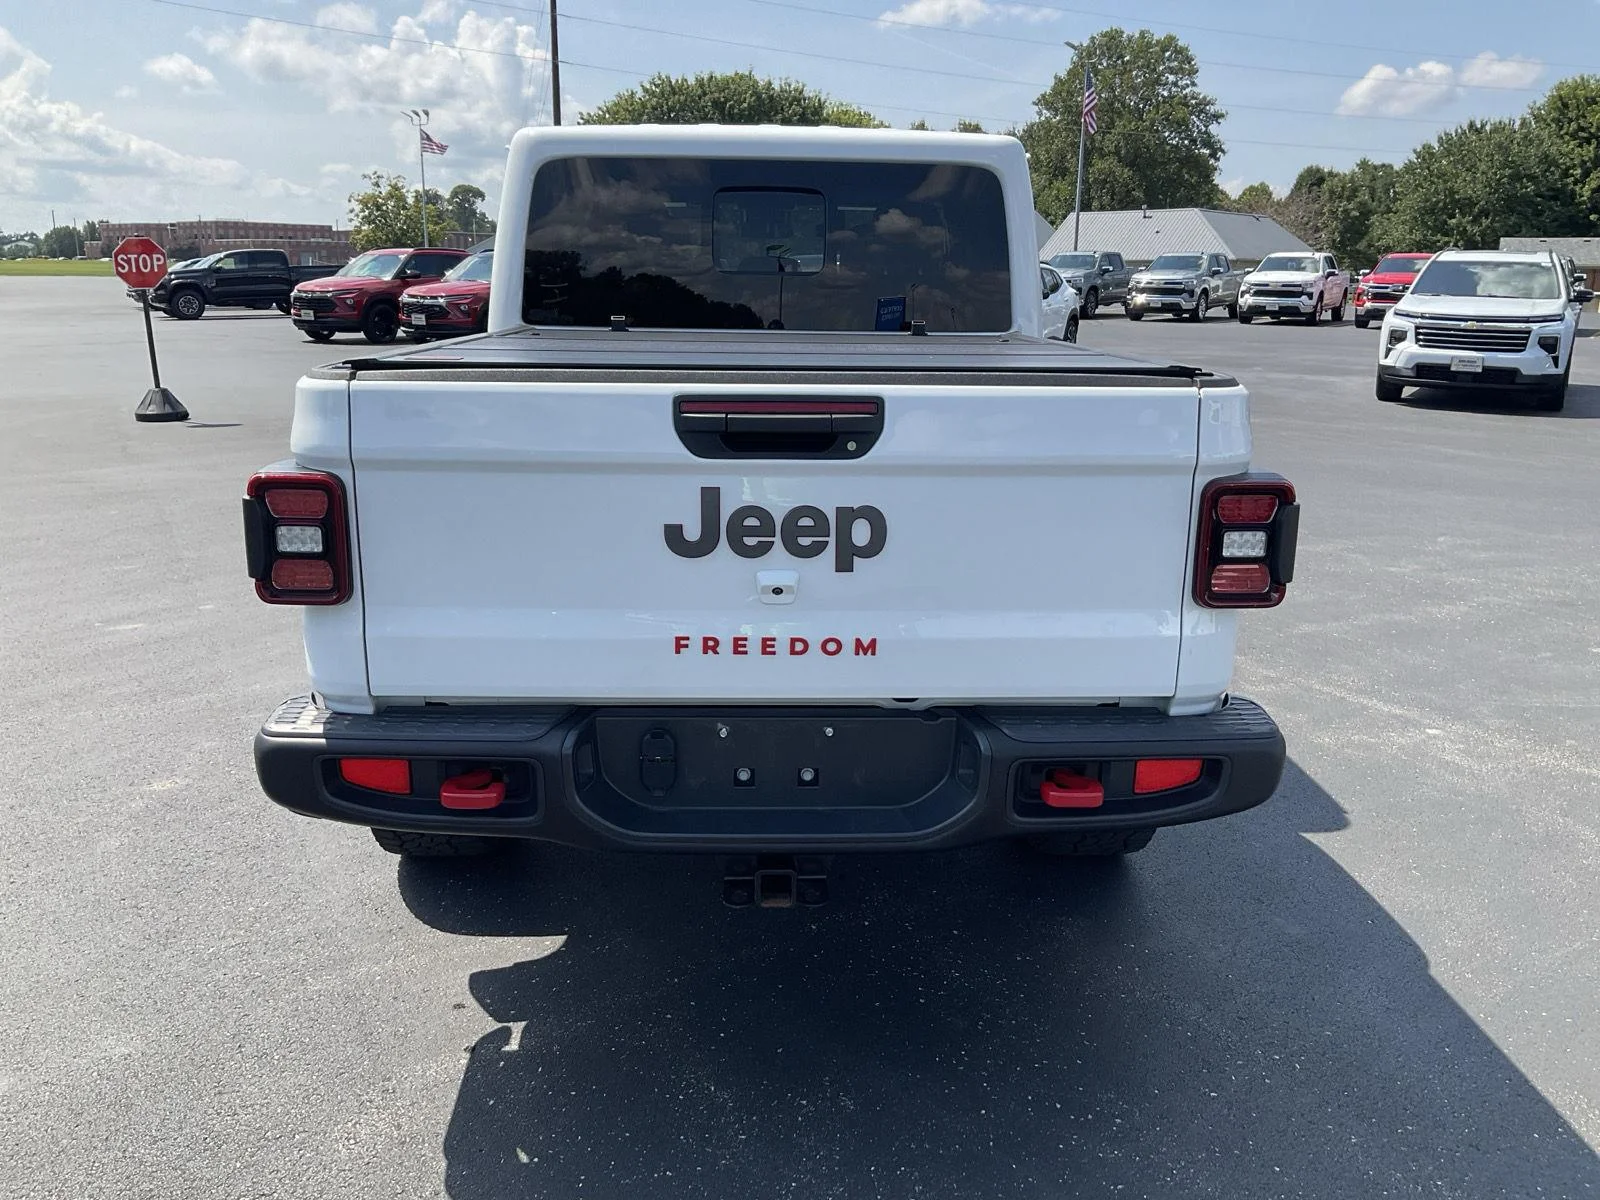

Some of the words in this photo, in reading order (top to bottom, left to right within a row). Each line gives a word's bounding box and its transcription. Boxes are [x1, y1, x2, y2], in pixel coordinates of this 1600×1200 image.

[117, 254, 164, 273] STOP
[664, 486, 887, 573] Jeep
[674, 636, 878, 656] FREEDOM
